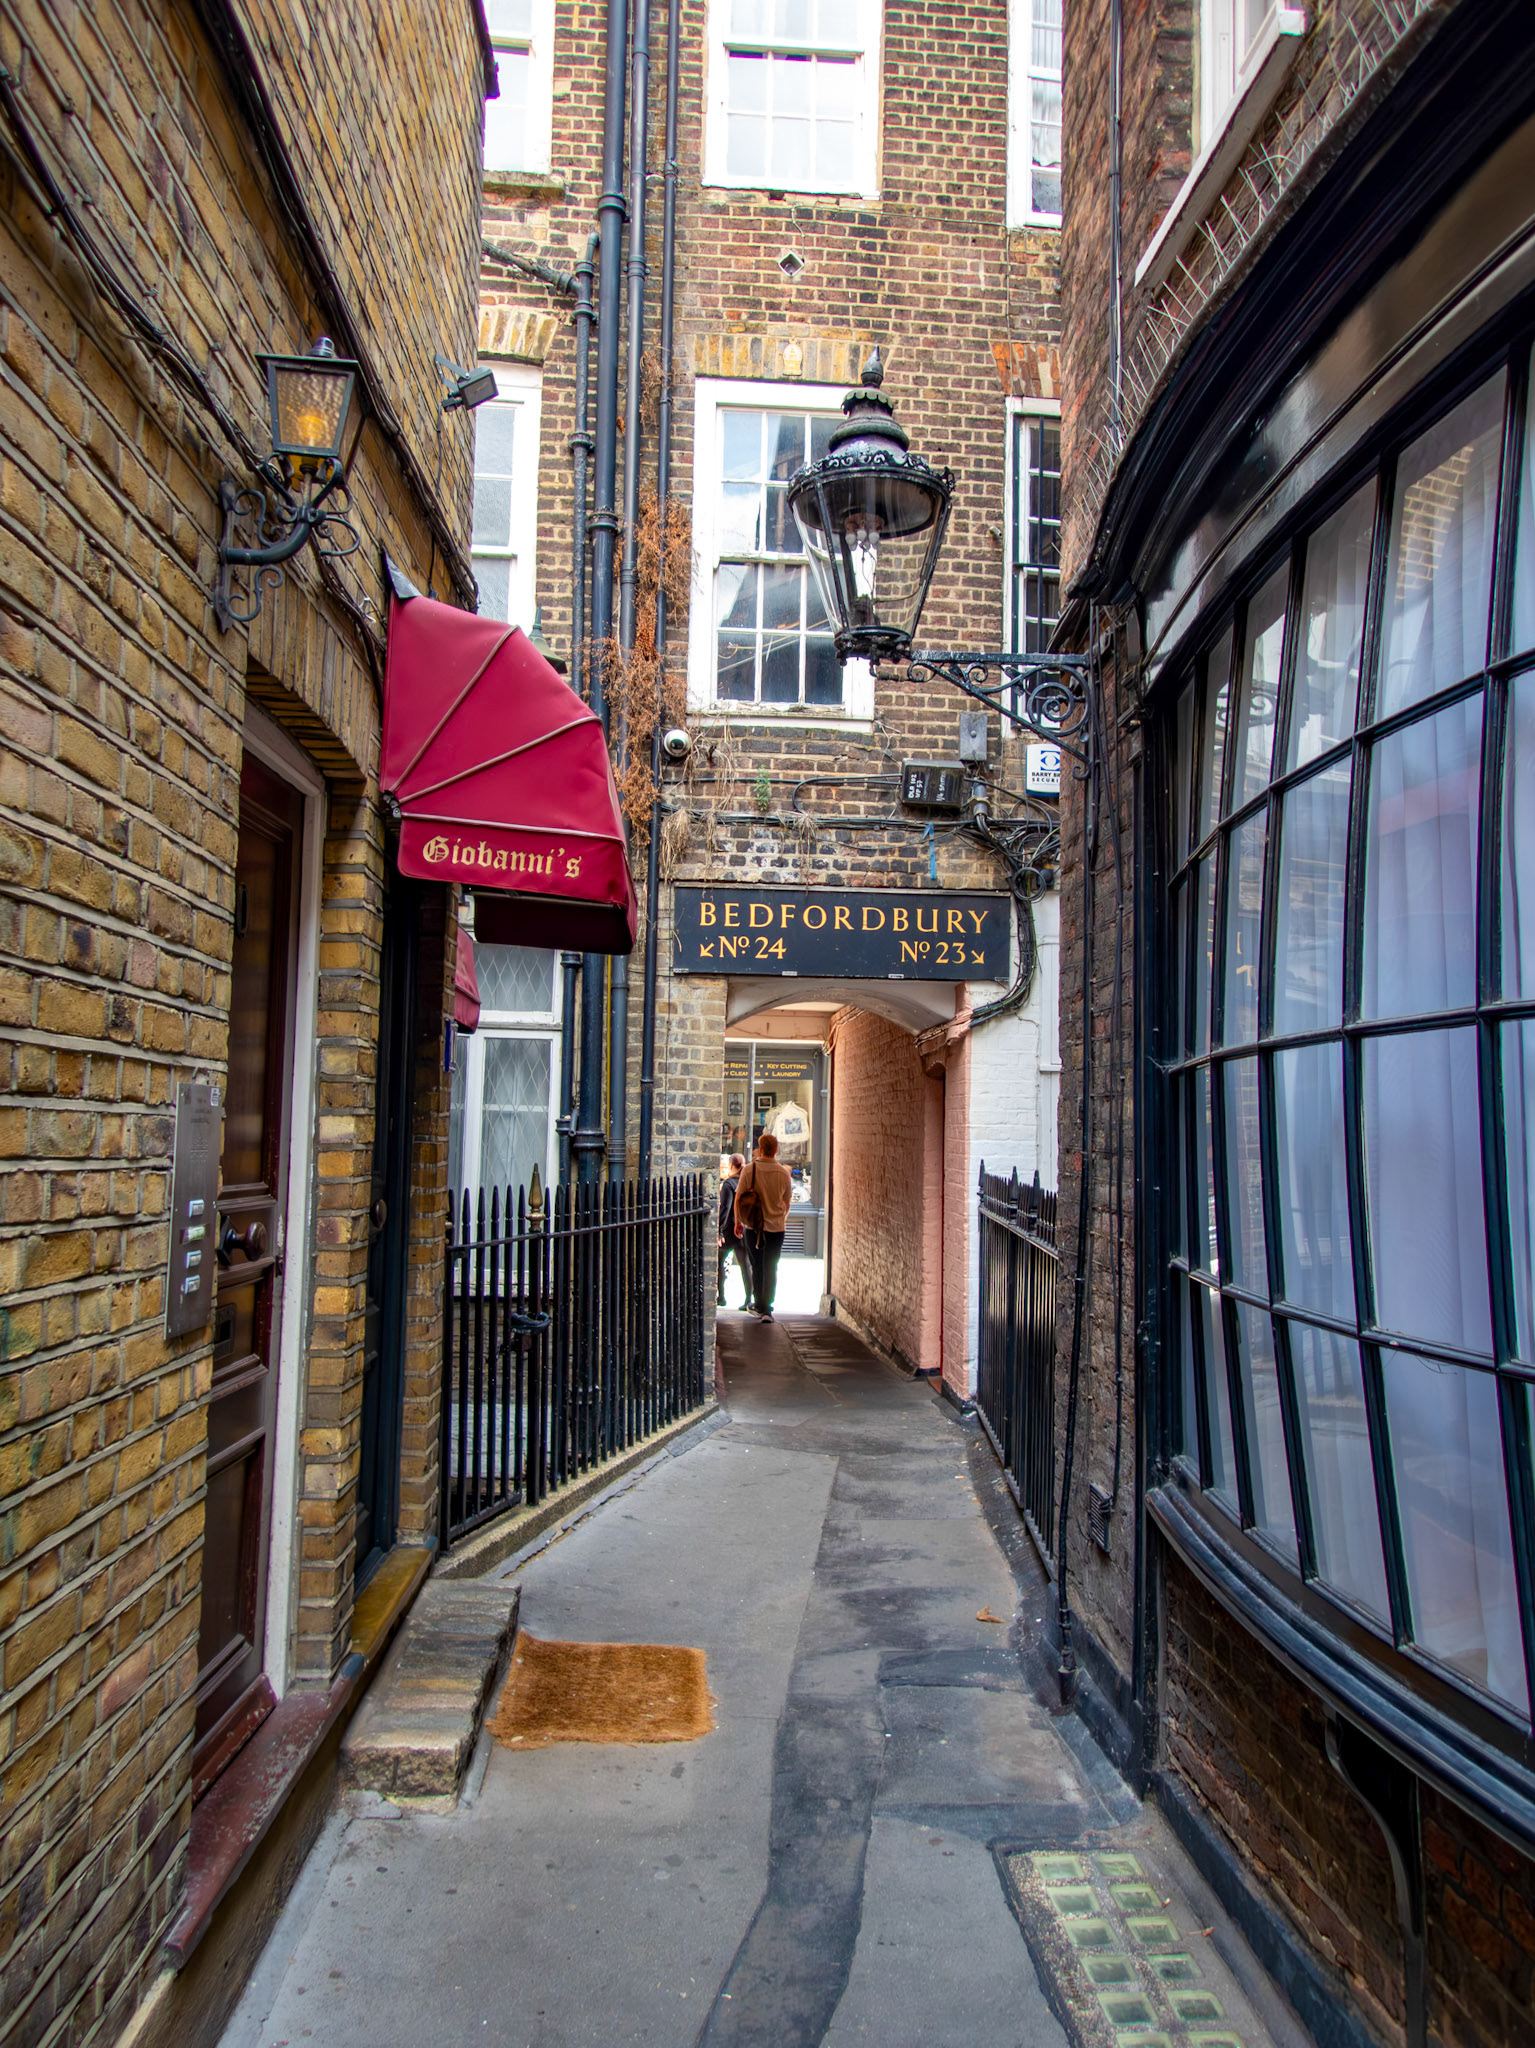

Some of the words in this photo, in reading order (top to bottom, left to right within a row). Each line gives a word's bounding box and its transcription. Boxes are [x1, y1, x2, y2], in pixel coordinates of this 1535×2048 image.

[699, 902, 989, 934] BEDFORDBURY
[754, 936, 787, 959] 24
[935, 941, 966, 964] 23
